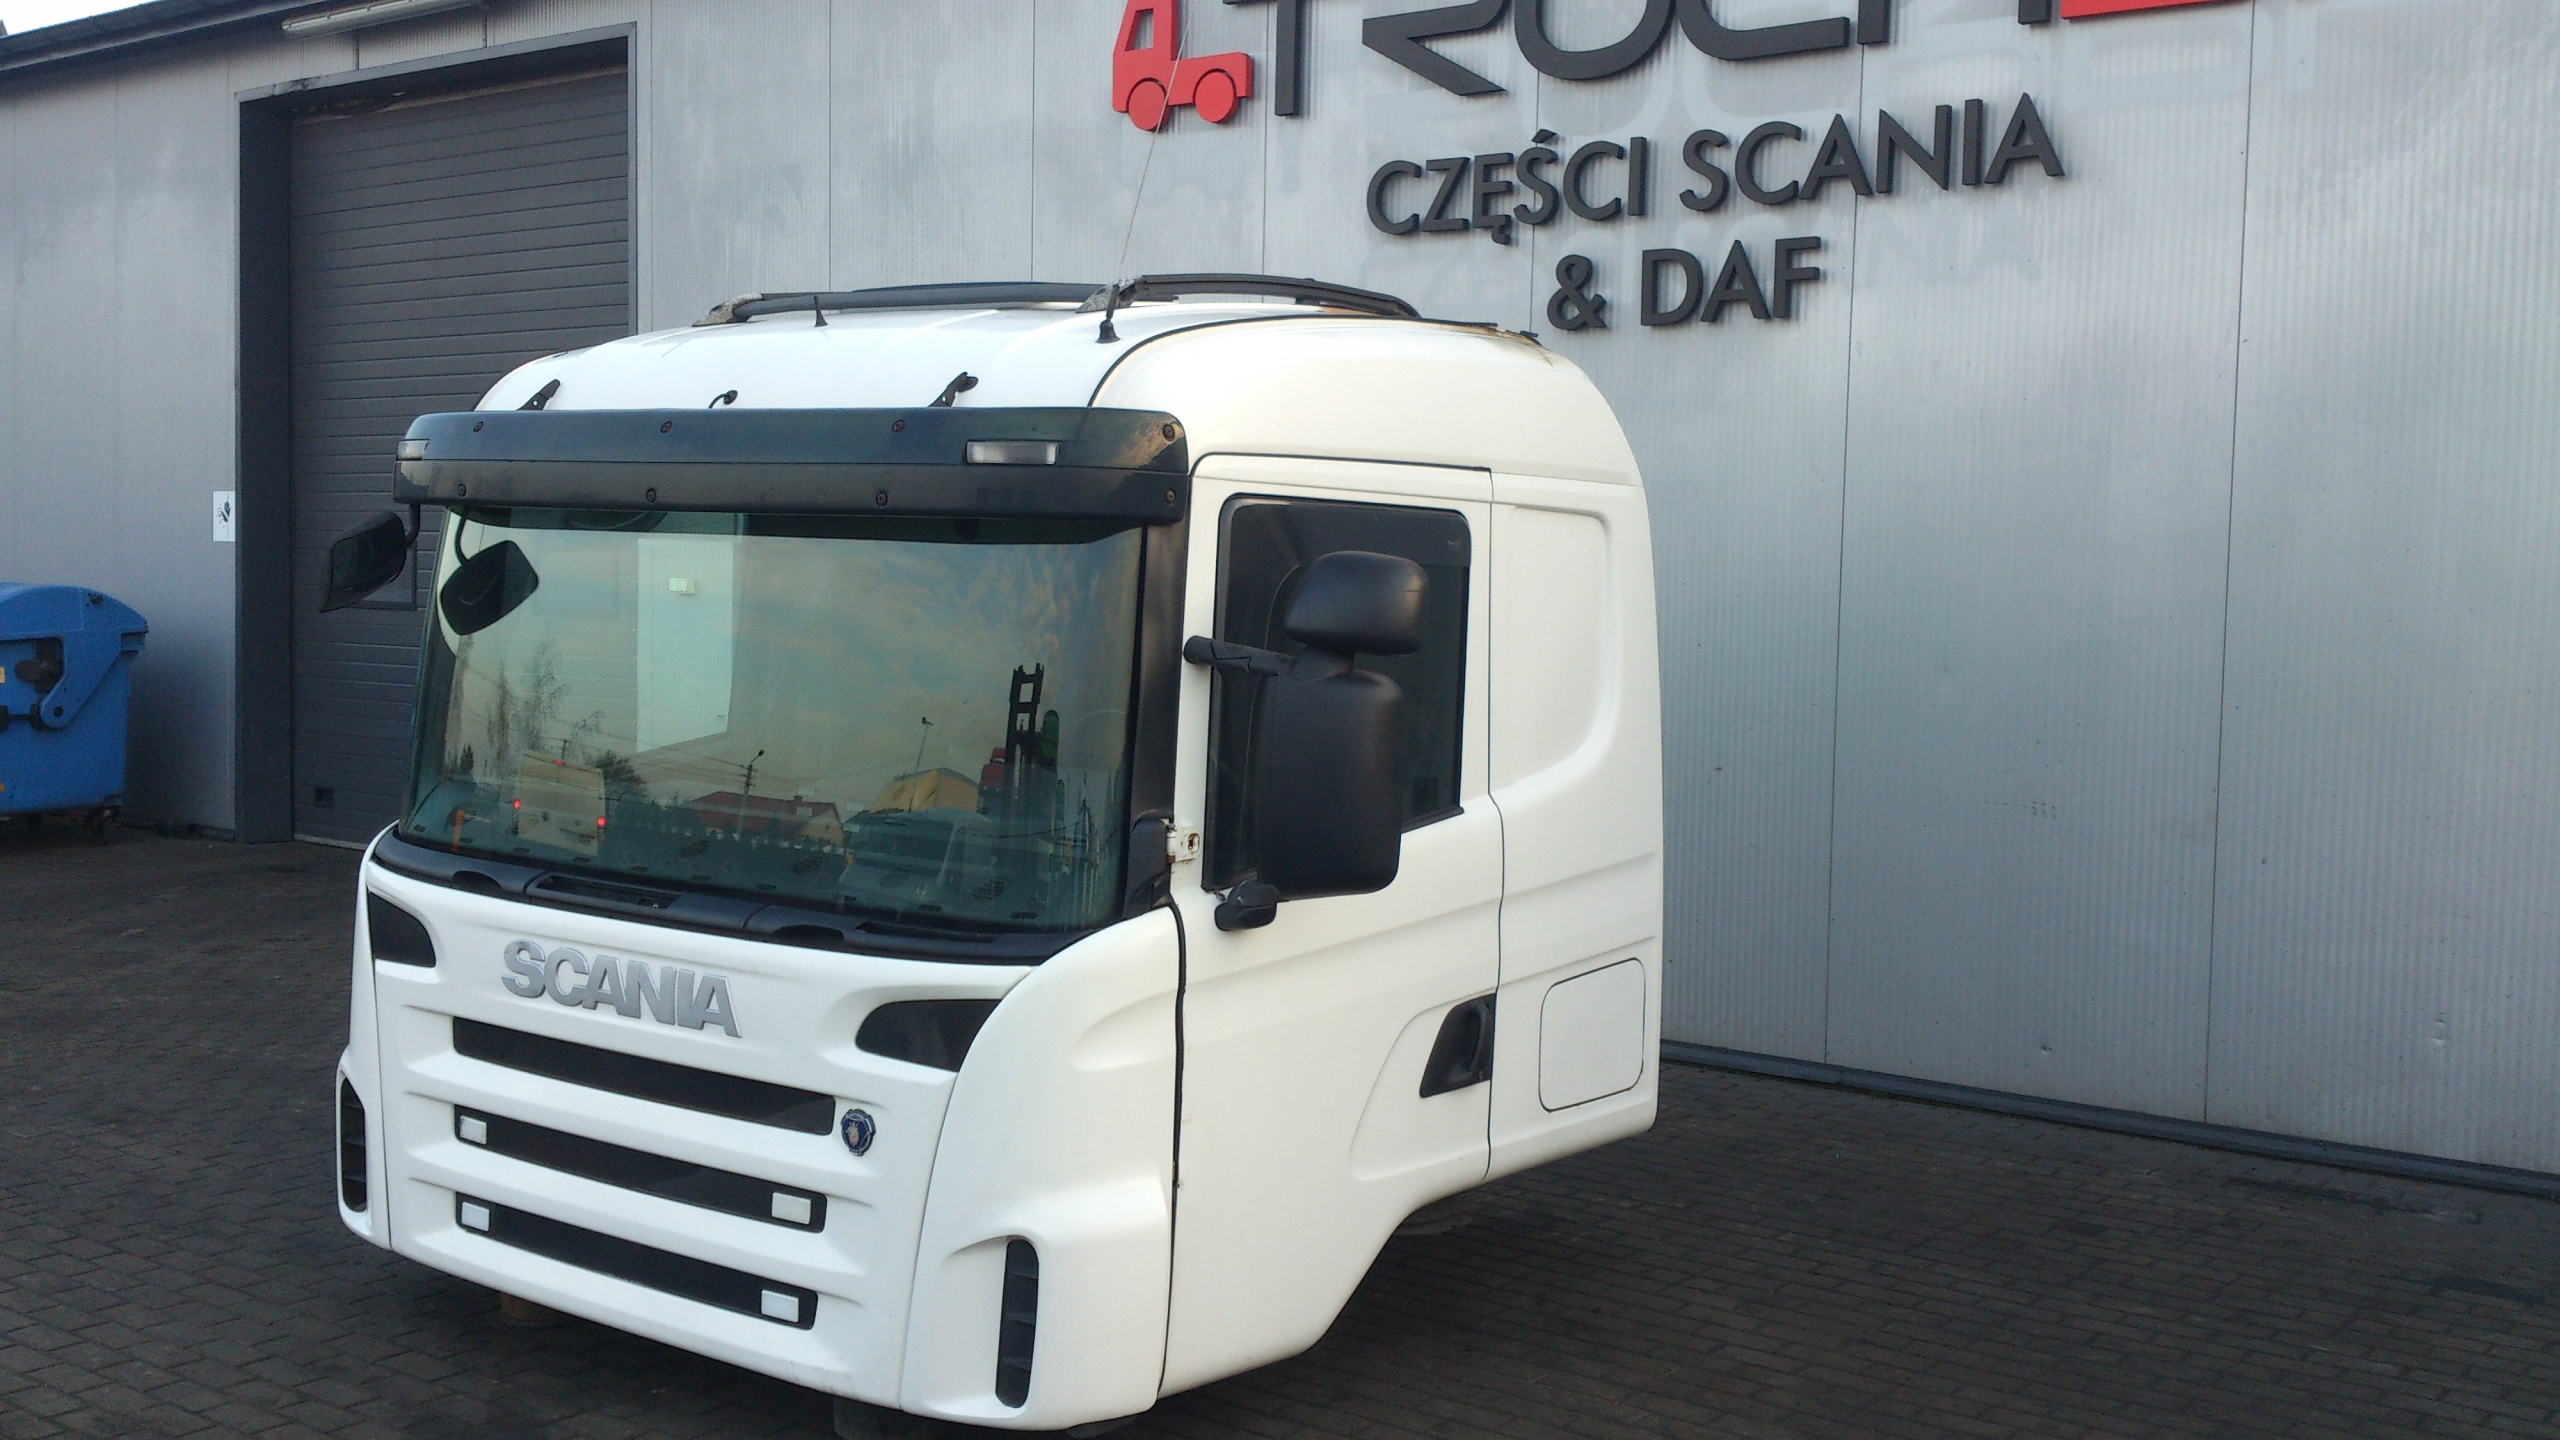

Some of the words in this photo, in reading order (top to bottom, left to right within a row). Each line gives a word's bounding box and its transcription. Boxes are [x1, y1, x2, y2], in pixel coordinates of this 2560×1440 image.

[1366, 129, 1648, 245] CZĘŚCI
[1679, 92, 2065, 212] SCANIA
[1547, 254, 1607, 331] &
[1641, 236, 1821, 326] DAF
[501, 939, 742, 1038] SCANIA
